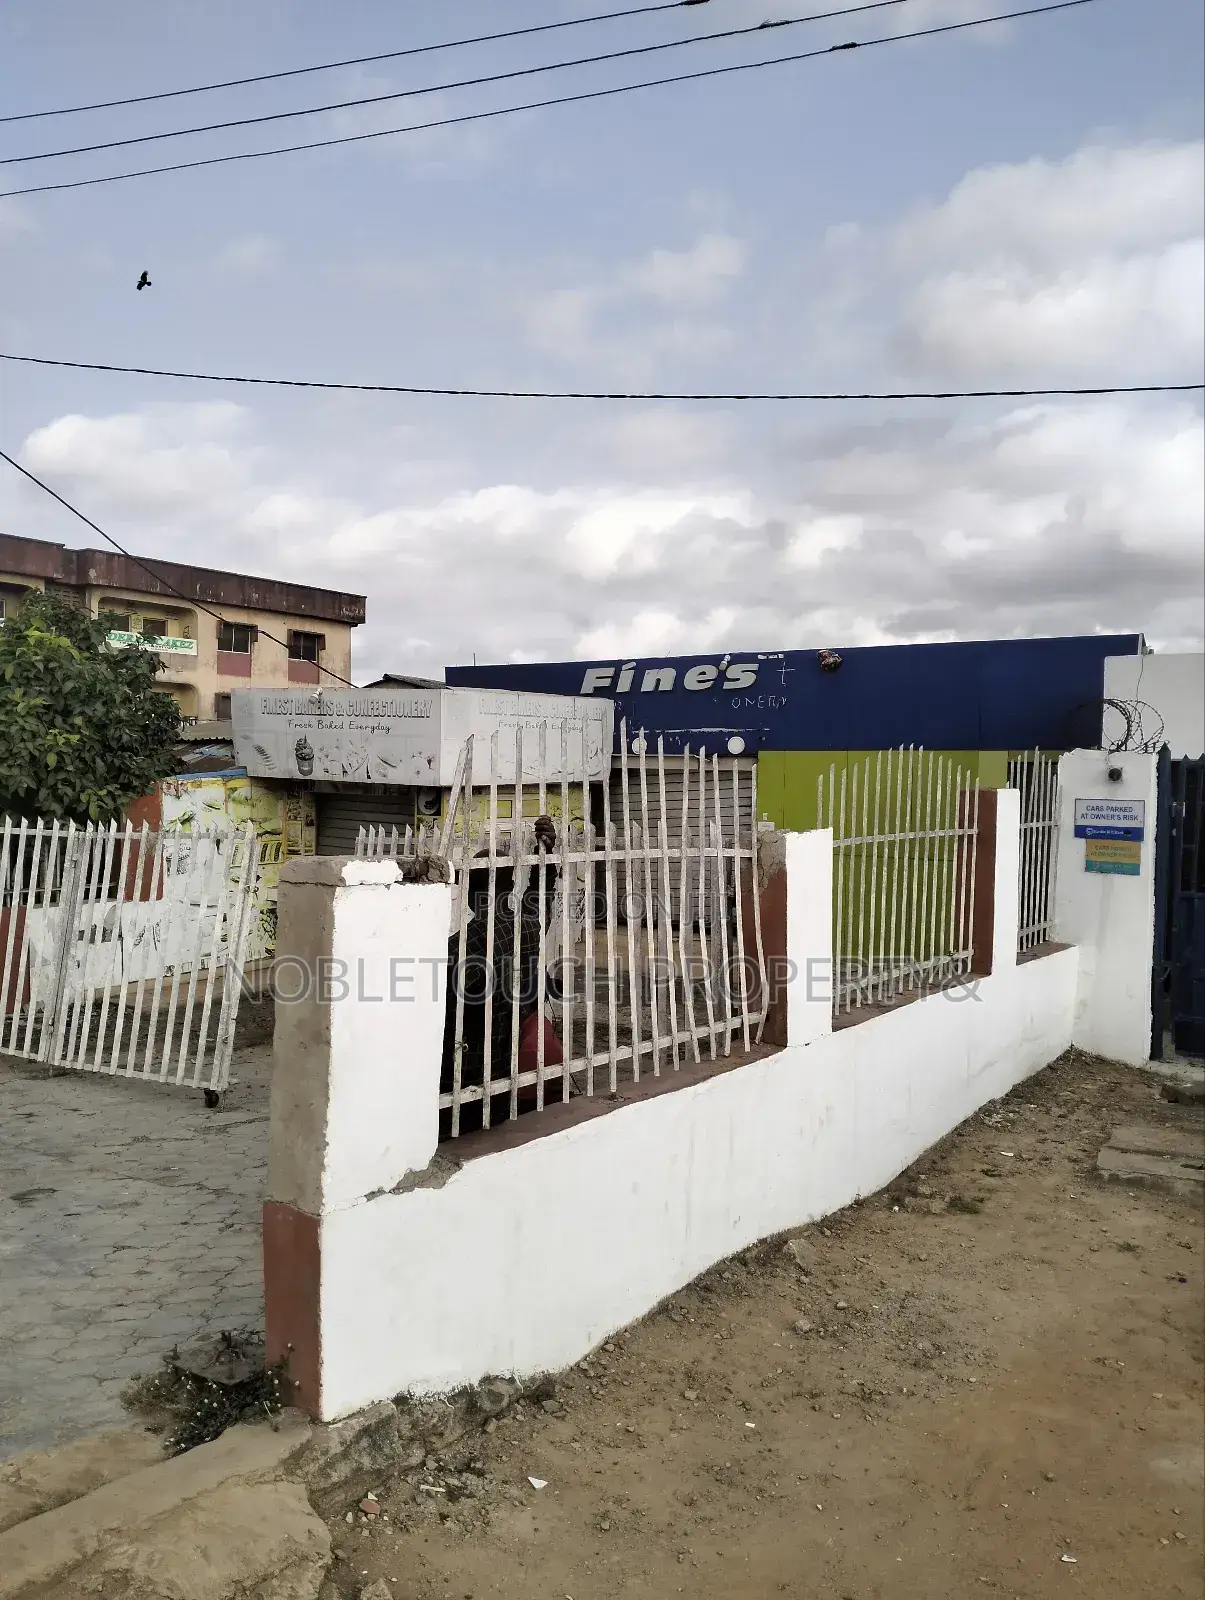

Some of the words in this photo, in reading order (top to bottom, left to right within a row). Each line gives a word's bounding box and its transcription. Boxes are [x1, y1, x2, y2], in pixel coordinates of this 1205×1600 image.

[260, 697, 294, 715] FINEST
[346, 698, 433, 719] CONFECTIONERY
[288, 719, 314, 729] Fresh
[317, 720, 345, 730] Baked
[348, 721, 391, 734] Everyday
[1106, 805, 1134, 813] PARKED
[1090, 813, 1121, 821] OWNER'S
